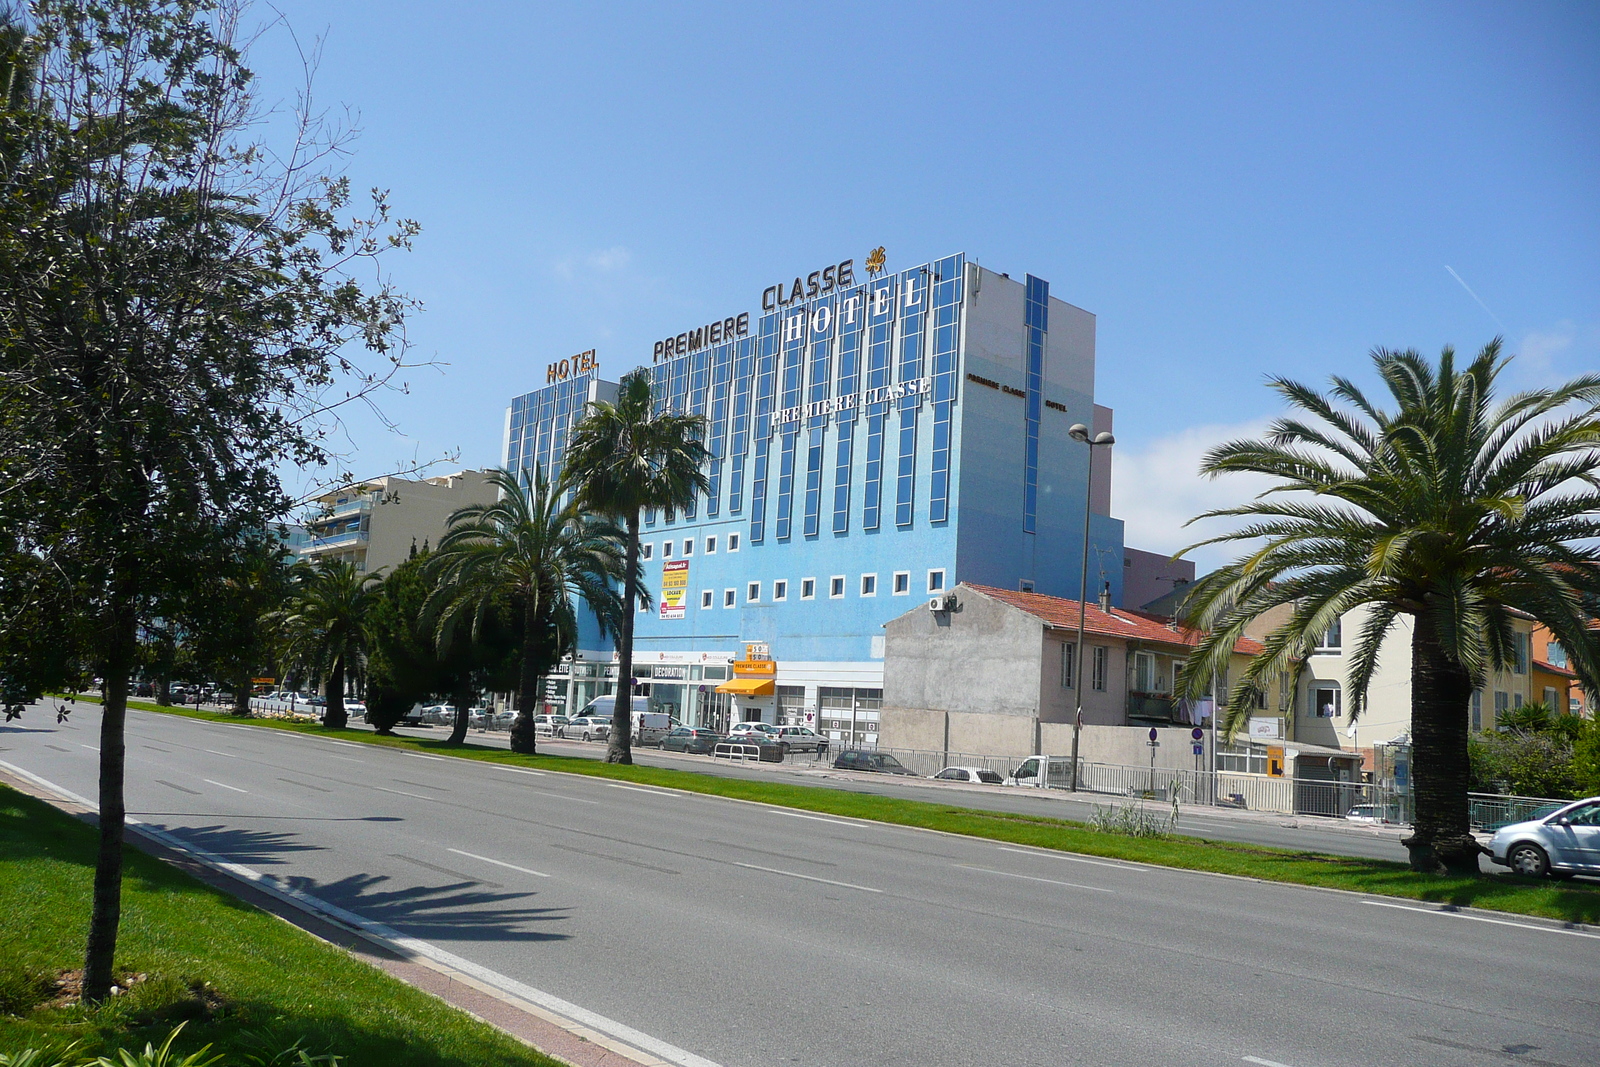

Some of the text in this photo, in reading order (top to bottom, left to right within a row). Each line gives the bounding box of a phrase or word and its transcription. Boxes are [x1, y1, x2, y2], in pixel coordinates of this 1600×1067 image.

[547, 259, 854, 384] HOTEL PREMIERE CLASSE
[785, 278, 922, 342] HOTEL
[771, 376, 931, 427] PREMIERE CLASSE
[967, 373, 1068, 413] PREMIERE CLASSE HOTEL
[654, 667, 686, 678] DECORATION
